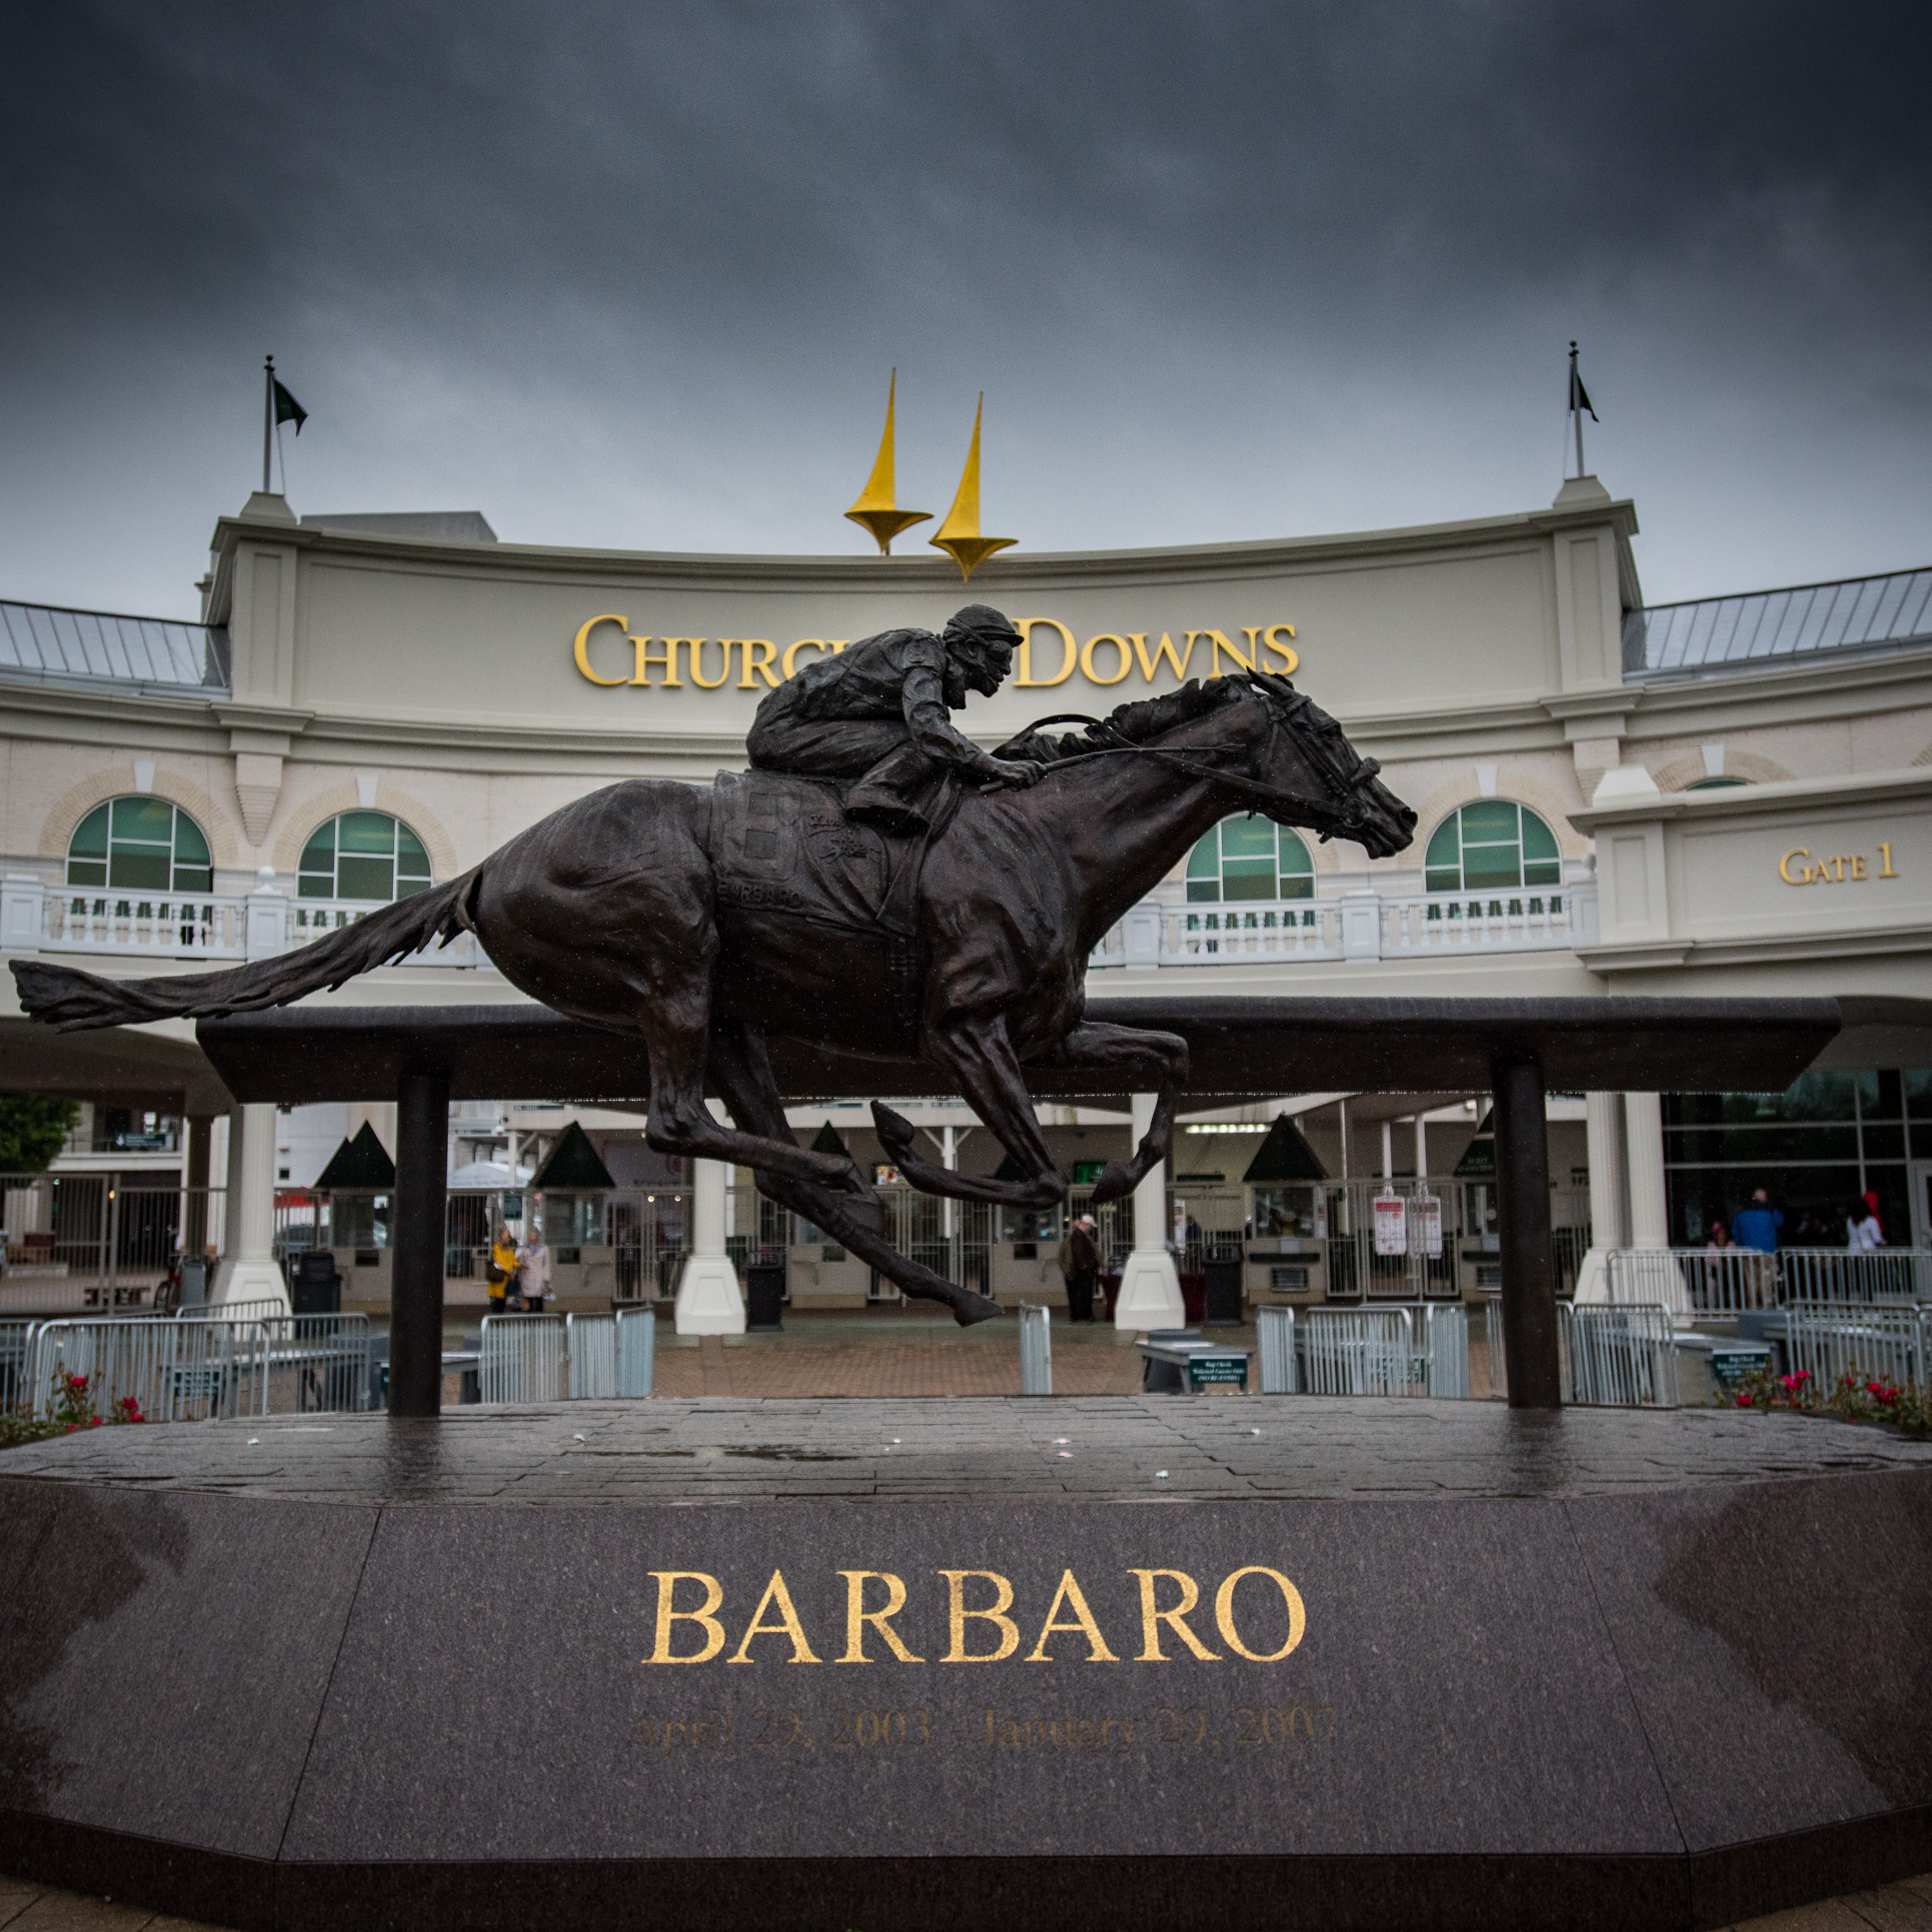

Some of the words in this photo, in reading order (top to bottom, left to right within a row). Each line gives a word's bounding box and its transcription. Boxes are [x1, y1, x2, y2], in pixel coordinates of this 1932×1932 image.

[574, 614, 851, 688] CHURC
[1012, 617, 1299, 686] DOWNS
[1779, 848, 1869, 886] GATE
[1878, 842, 1899, 878] 1
[717, 881, 802, 907] BARBARO
[642, 1566, 1306, 1663] BARBARO
[630, 1706, 733, 1759] April
[830, 1707, 930, 1748] 2003
[982, 1708, 1141, 1755] January
[1234, 1704, 1336, 1748] 2007
